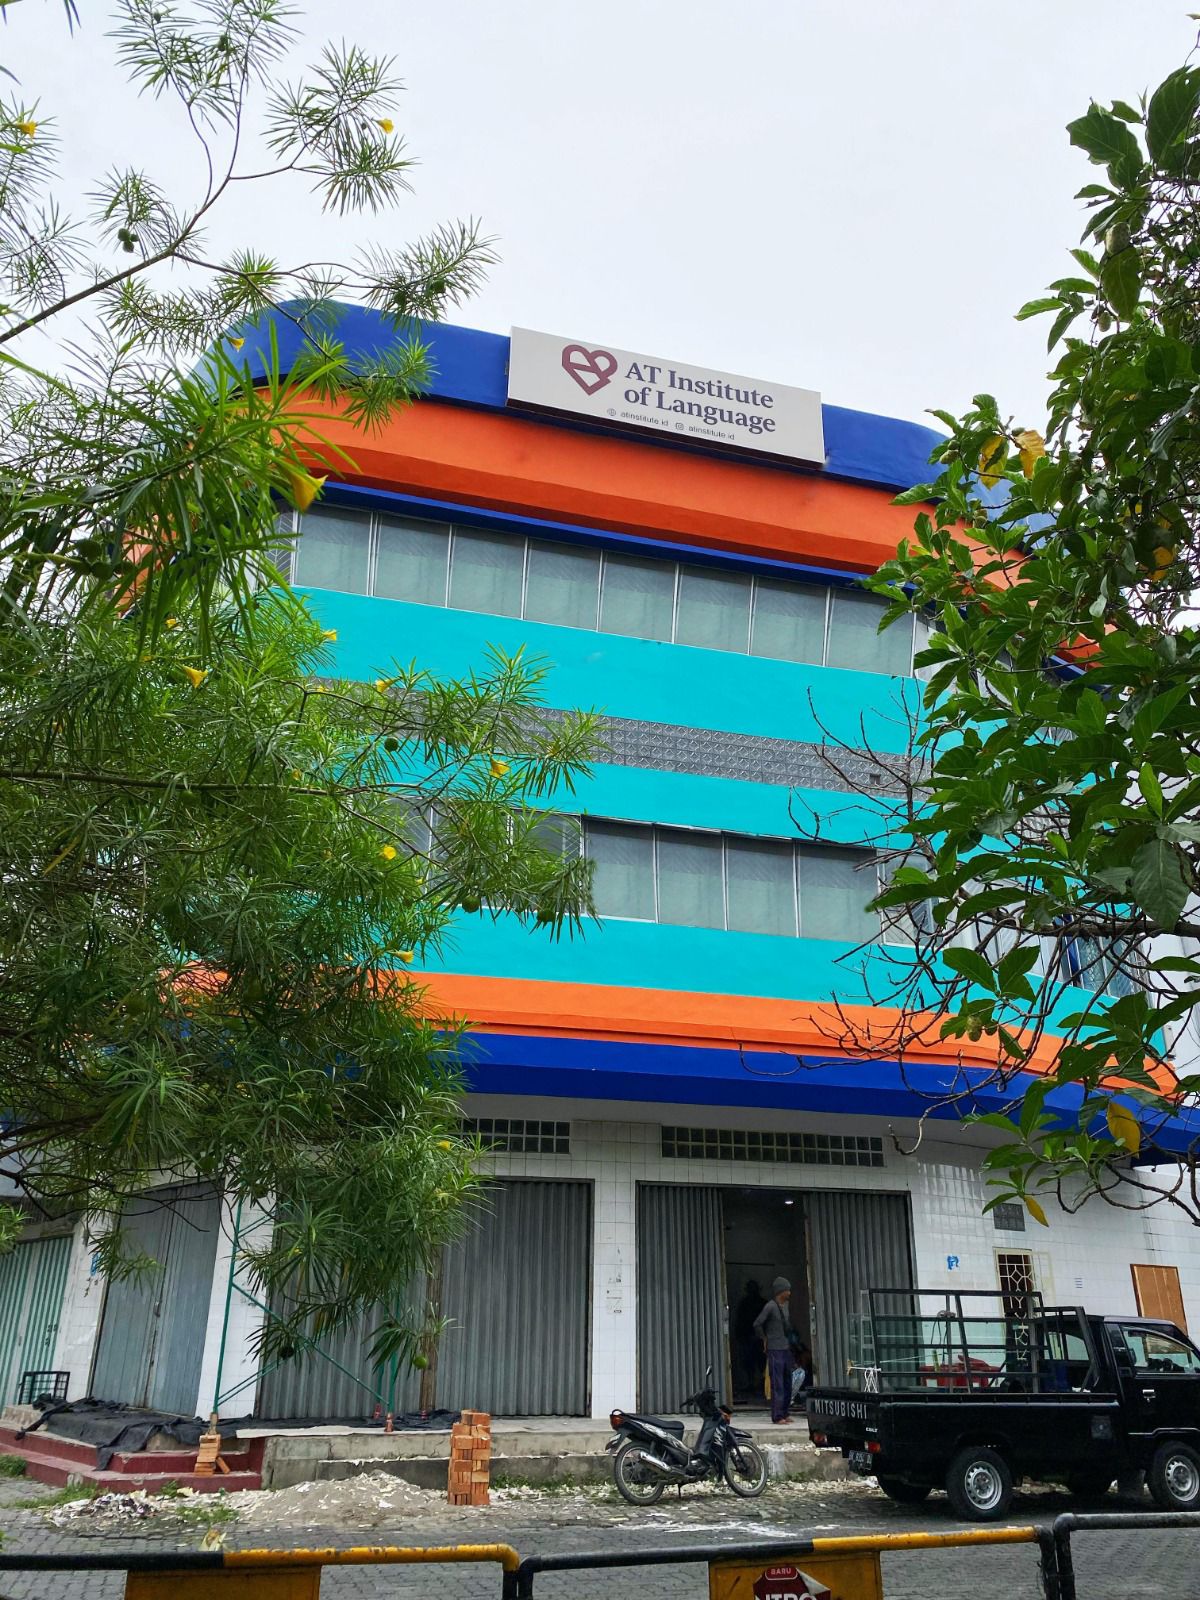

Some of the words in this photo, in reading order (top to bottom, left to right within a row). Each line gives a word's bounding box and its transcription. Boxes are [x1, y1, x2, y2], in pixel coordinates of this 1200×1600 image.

[625, 362, 661, 384] AT
[668, 369, 774, 409] Institute
[624, 386, 652, 406] of
[656, 390, 776, 435] Language
[815, 1399, 867, 1419] MITSUBISHI
